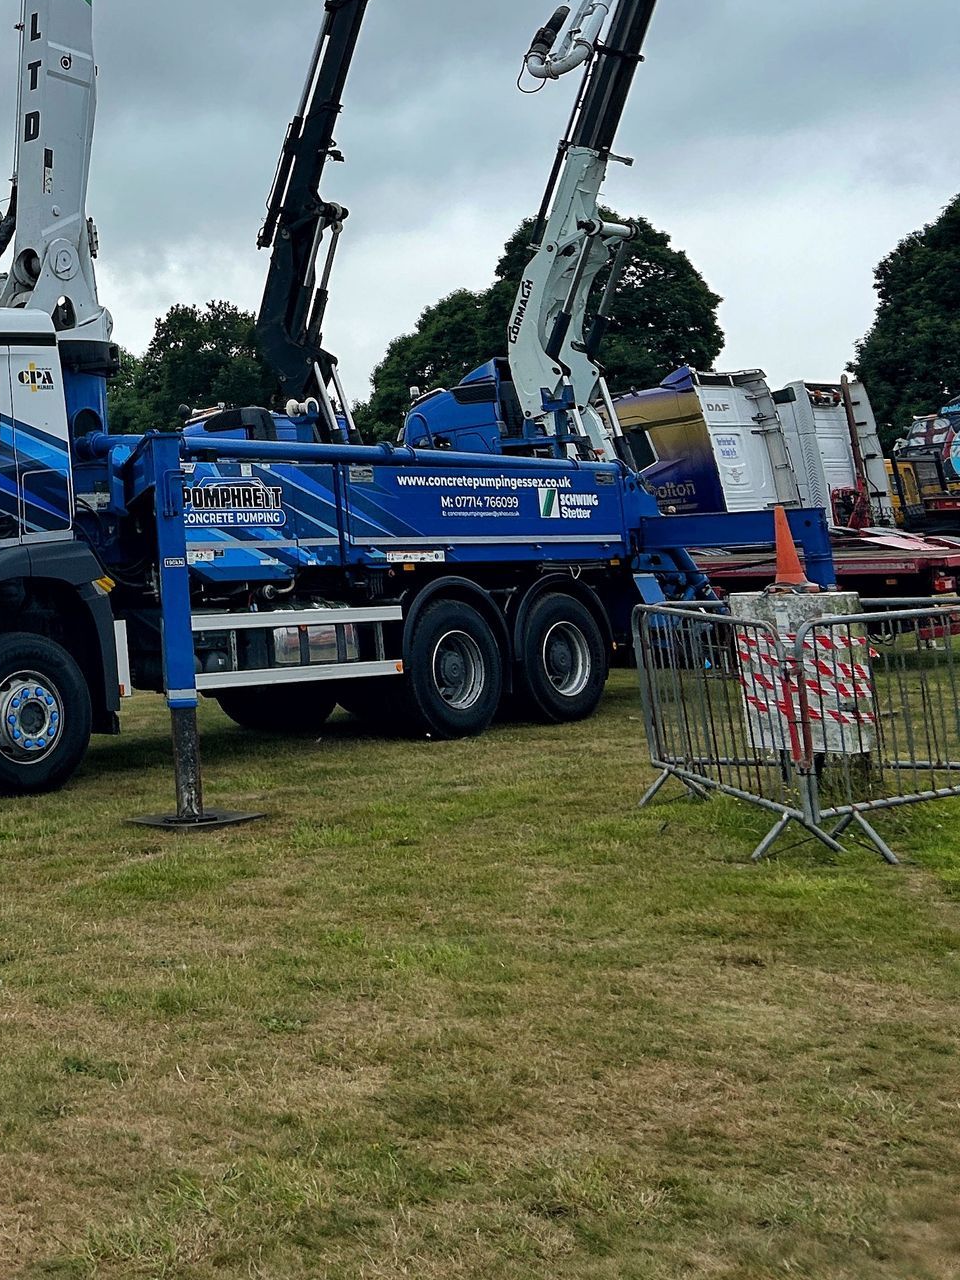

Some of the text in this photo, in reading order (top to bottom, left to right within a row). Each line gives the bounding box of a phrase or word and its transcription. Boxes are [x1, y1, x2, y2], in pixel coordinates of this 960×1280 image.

[24, 12, 42, 143] LTD
[17, 370, 54, 384] CPA
[397, 474, 571, 490] www.concretepumpingessex.co.uk
[183, 487, 282, 508] POMPHRETT
[440, 495, 519, 508] M: 07714 766099
[560, 494, 599, 506] SCHWING
[236, 513, 280, 523] PUMPING
[561, 506, 591, 519] Stetter
